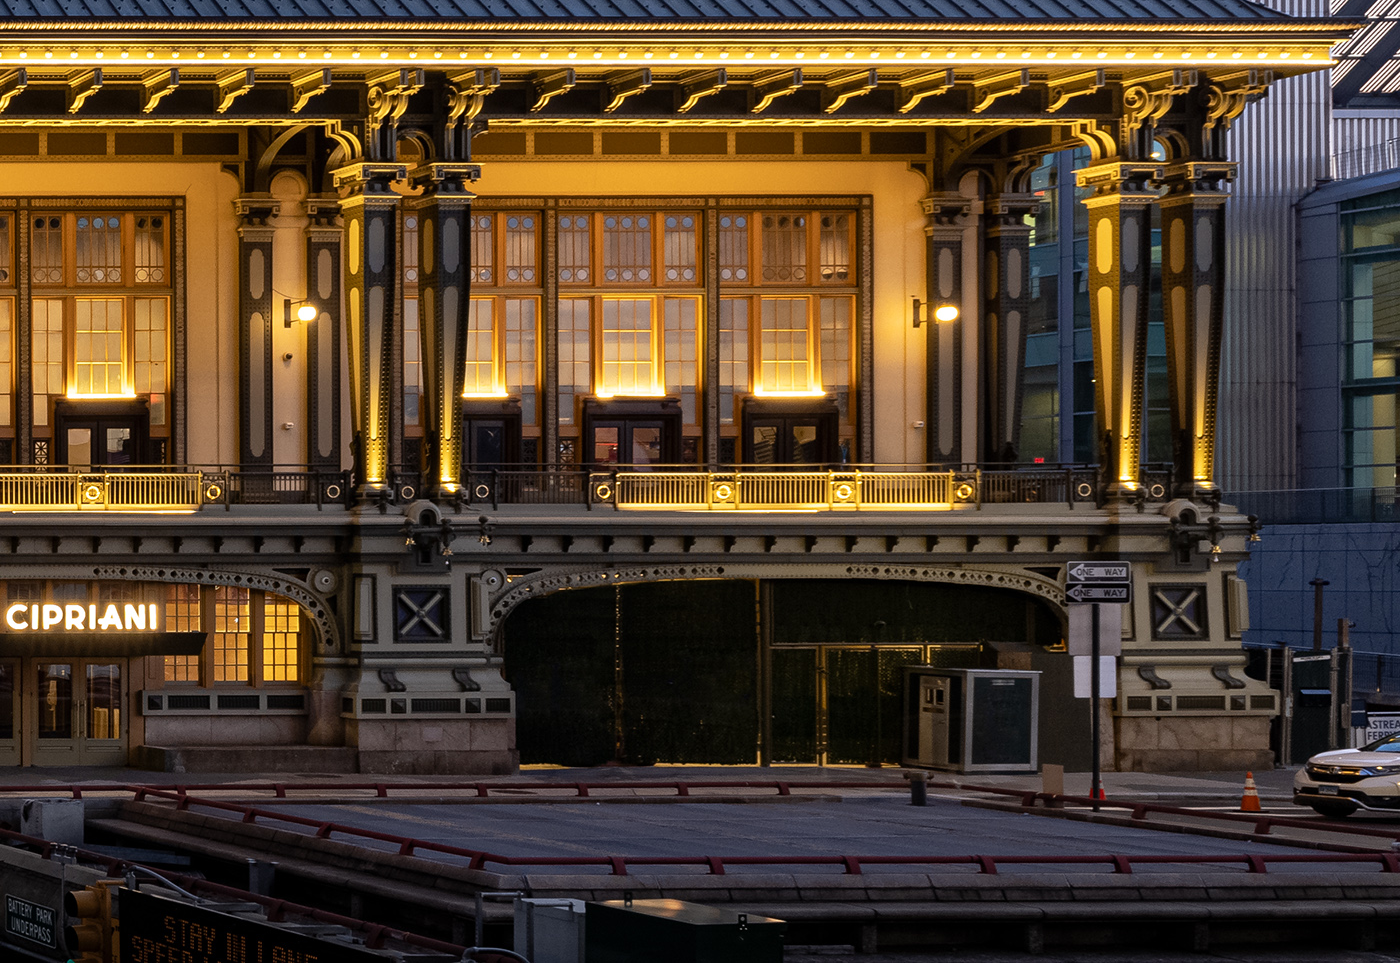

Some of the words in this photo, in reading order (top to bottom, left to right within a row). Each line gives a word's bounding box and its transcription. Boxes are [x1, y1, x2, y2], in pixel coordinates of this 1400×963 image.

[1076, 568, 1094, 576] ONE
[1104, 568, 1124, 576] WAY
[1073, 589, 1093, 597] ONE
[1103, 589, 1124, 597] WAY
[6, 603, 158, 630] CIPRIANI
[8, 898, 32, 919] BATTERY
[36, 907, 53, 926] PARK
[11, 915, 51, 943] UNDERPASS
[164, 915, 216, 955] STAY
[226, 932, 246, 962] IN
